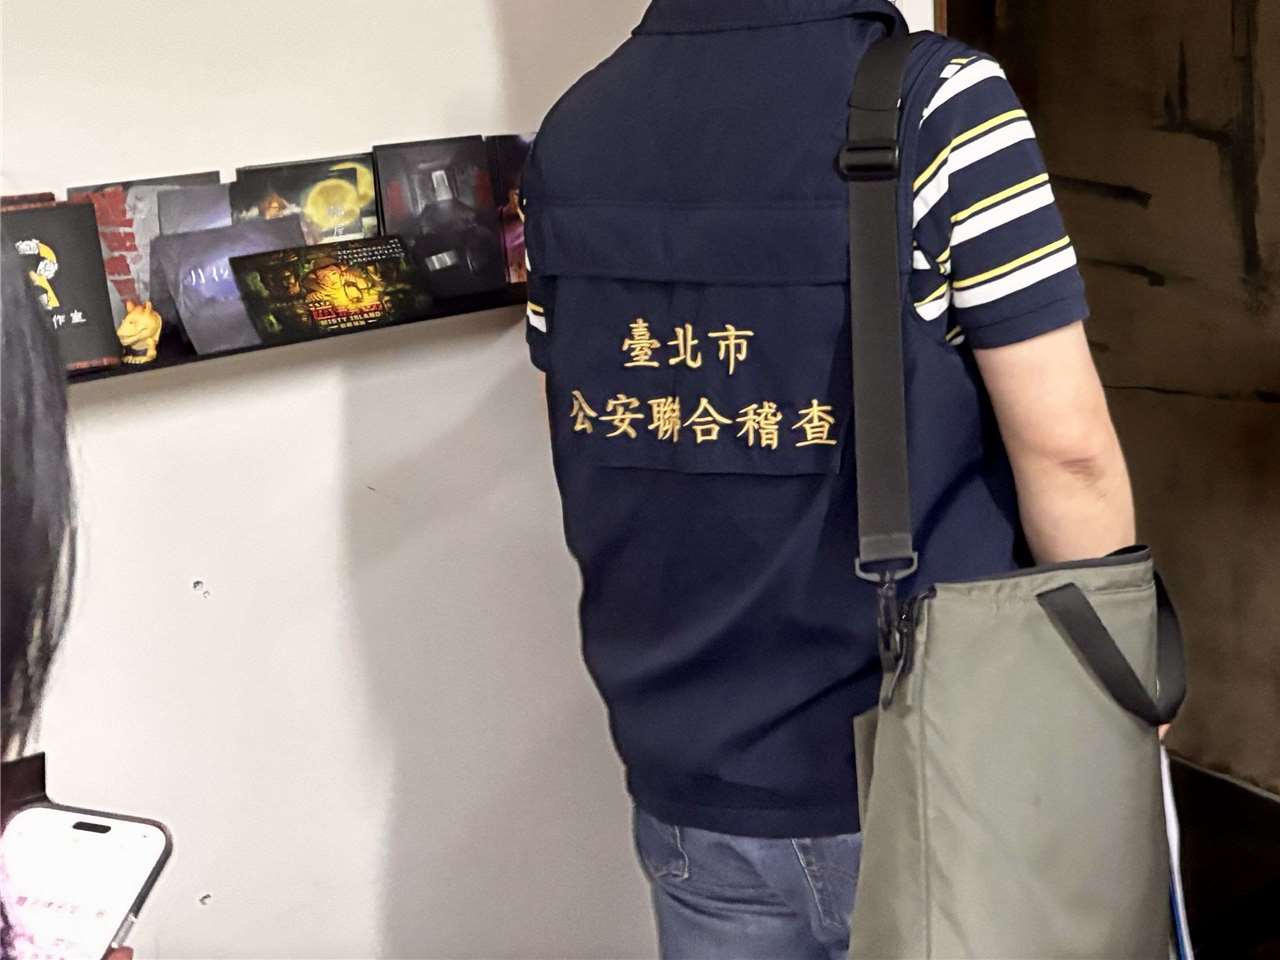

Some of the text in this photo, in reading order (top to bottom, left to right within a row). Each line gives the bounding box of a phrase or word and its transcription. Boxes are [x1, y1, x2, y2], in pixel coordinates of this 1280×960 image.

[349, 311, 381, 321] ISLAND
[622, 318, 754, 375] 臺北市
[569, 390, 838, 450] 公安聯合稽查
